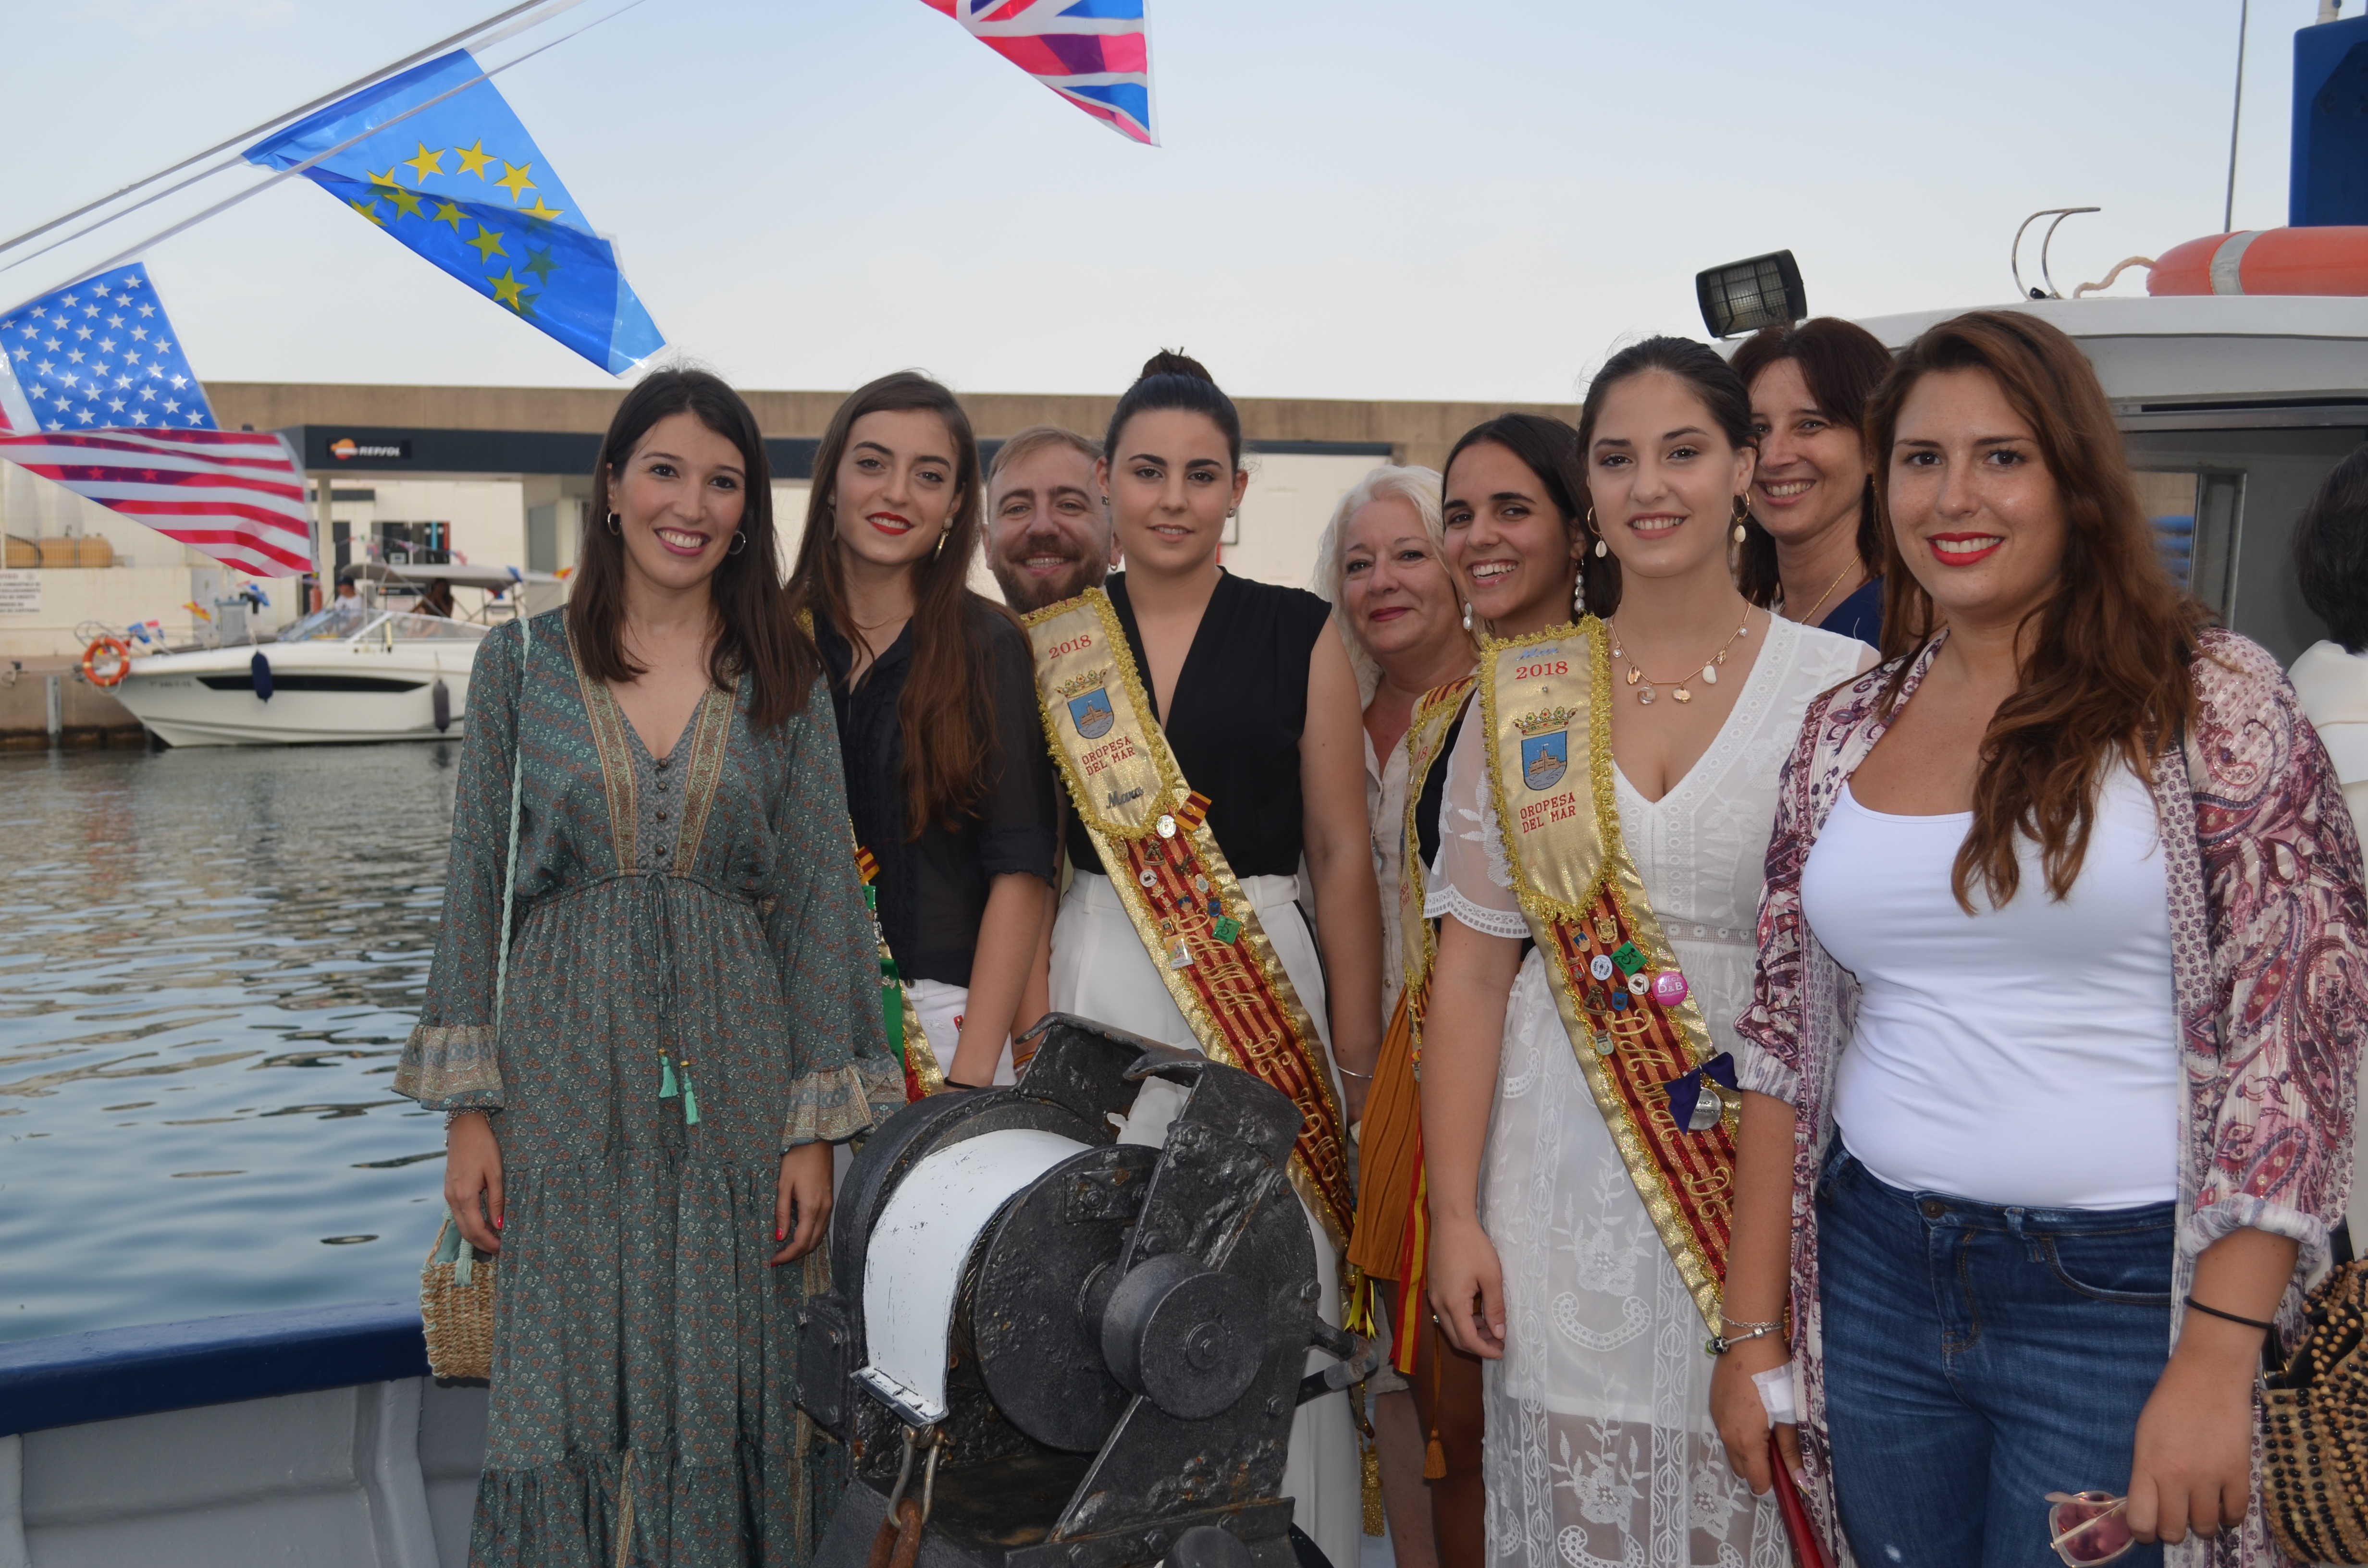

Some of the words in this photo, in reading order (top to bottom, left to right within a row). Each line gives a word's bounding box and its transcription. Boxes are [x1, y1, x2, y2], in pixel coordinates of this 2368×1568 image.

[359, 446, 400, 457] REPSOL
[1048, 635, 1092, 660] 2018
[1515, 661, 1568, 680] 2018
[1082, 736, 1131, 765] OROPESA
[1085, 760, 1108, 776] DEL
[1111, 747, 1135, 763] MAR
[1520, 792, 1576, 819] OROPESA
[1522, 816, 1544, 833] DEL
[1550, 805, 1576, 822] MAR
[1171, 907, 1261, 1016] DAMA
[1244, 1030, 1293, 1076] DE
